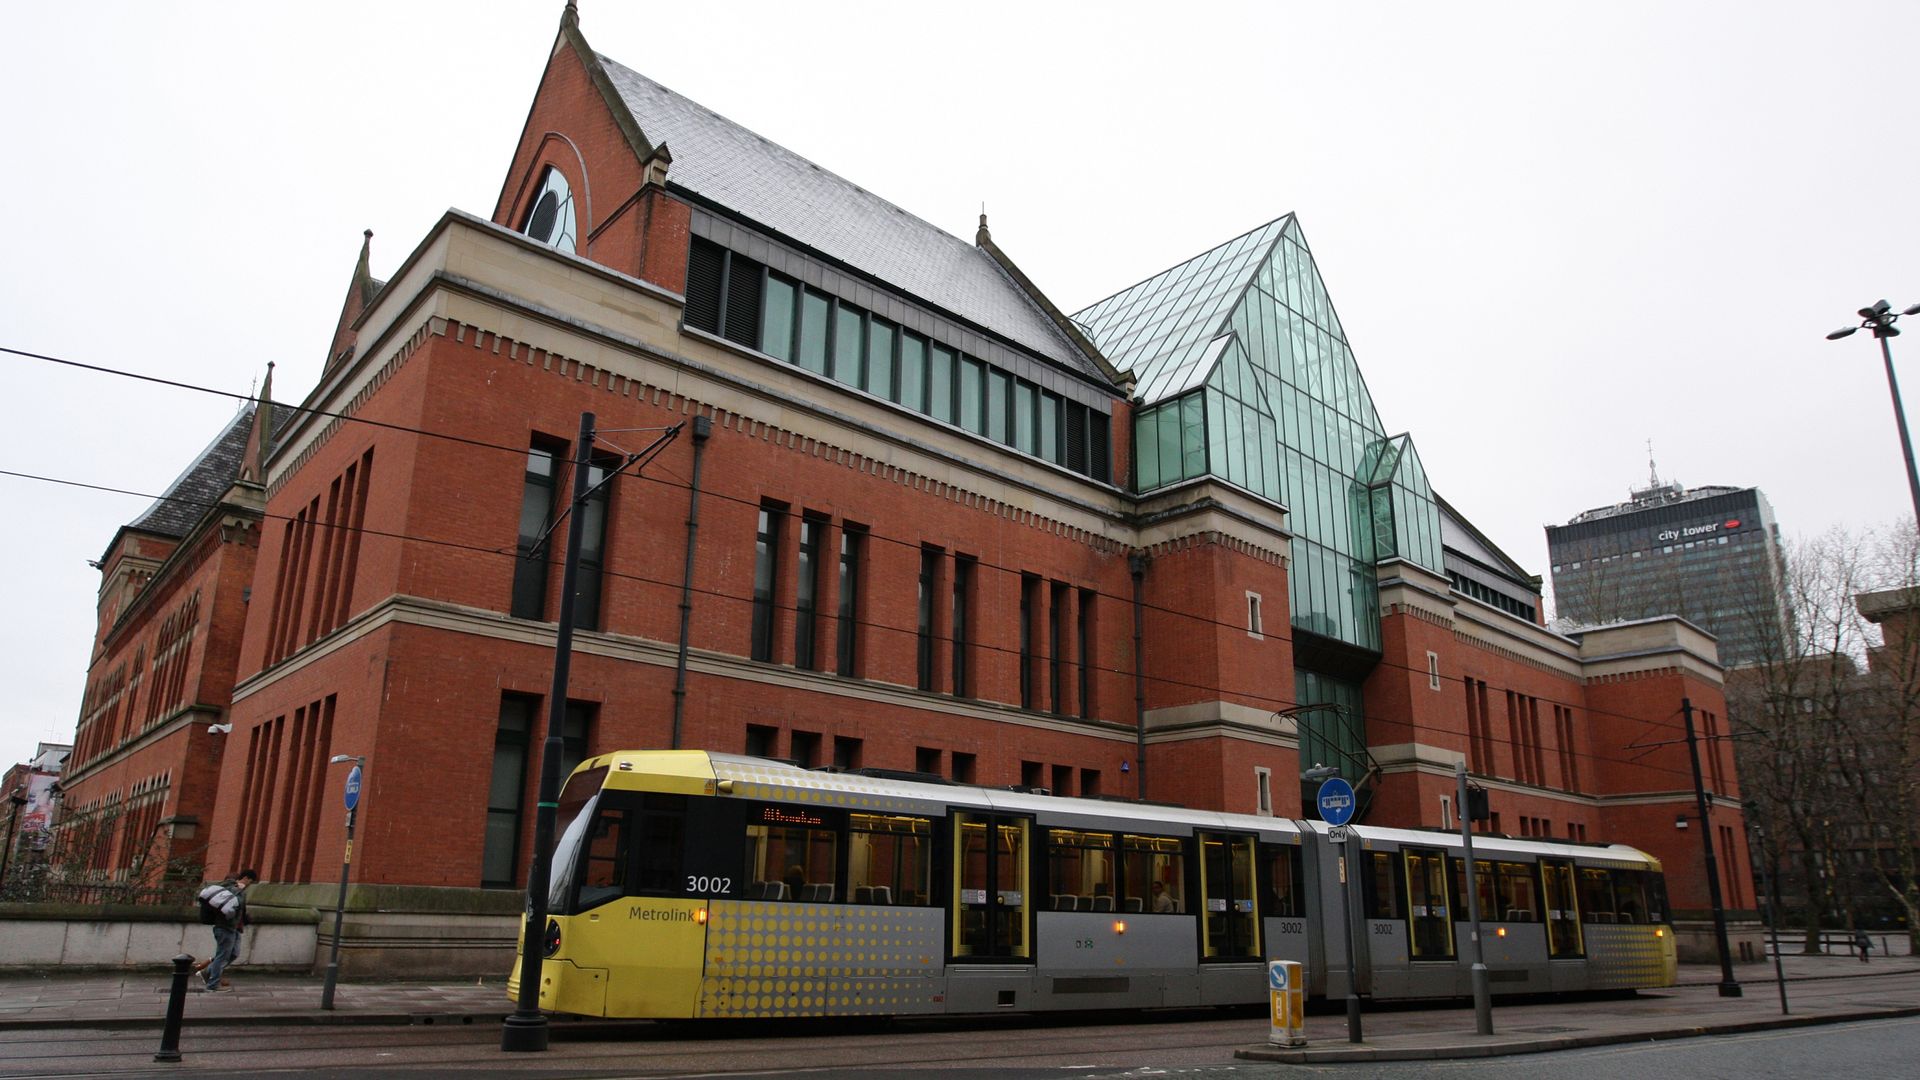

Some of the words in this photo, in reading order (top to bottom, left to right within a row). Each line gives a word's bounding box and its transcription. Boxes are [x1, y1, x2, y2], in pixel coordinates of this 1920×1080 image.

[1658, 530, 1679, 541] city
[1682, 523, 1719, 537] tower
[1329, 830, 1346, 840] Only
[686, 875, 731, 894] 3002
[629, 906, 696, 922] Metrolink
[1281, 922, 1303, 934] 3002
[1374, 924, 1393, 935] 3002
